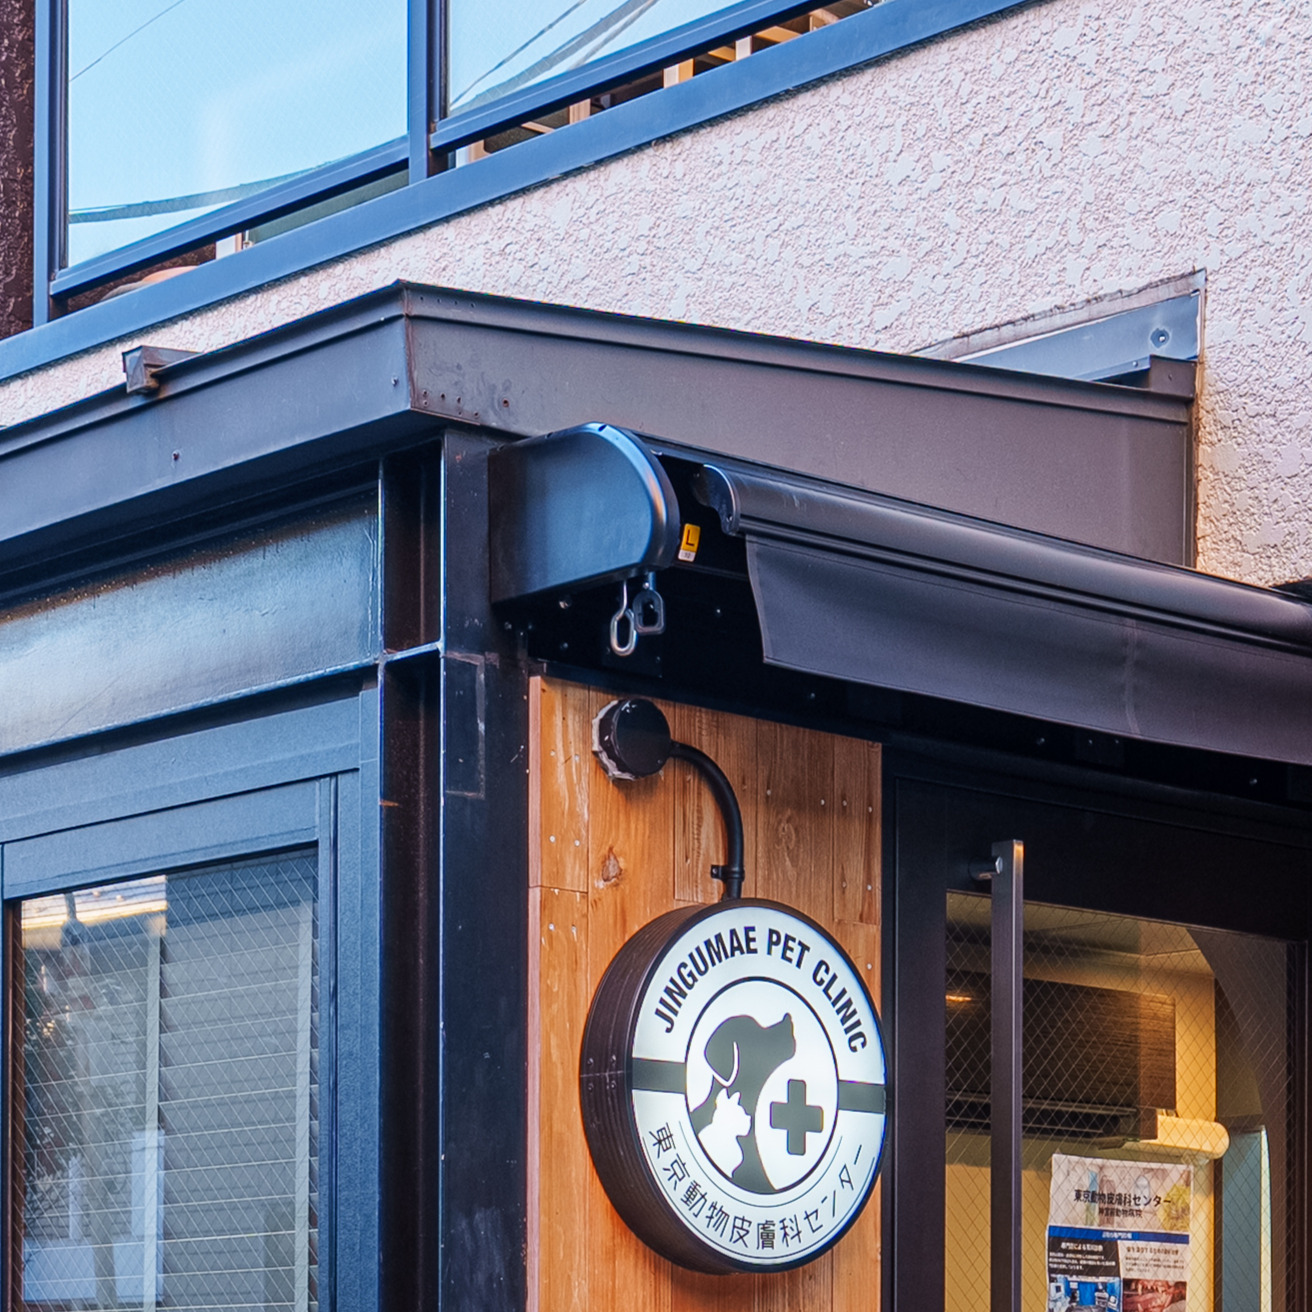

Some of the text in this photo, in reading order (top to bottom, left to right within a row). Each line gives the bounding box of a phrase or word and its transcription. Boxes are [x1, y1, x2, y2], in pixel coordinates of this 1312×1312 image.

[686, 529, 694, 547] L
[654, 926, 868, 1054] JINGUMAE PET CLINIC
[648, 1122, 862, 1250] 東京動物皮膚科センター
